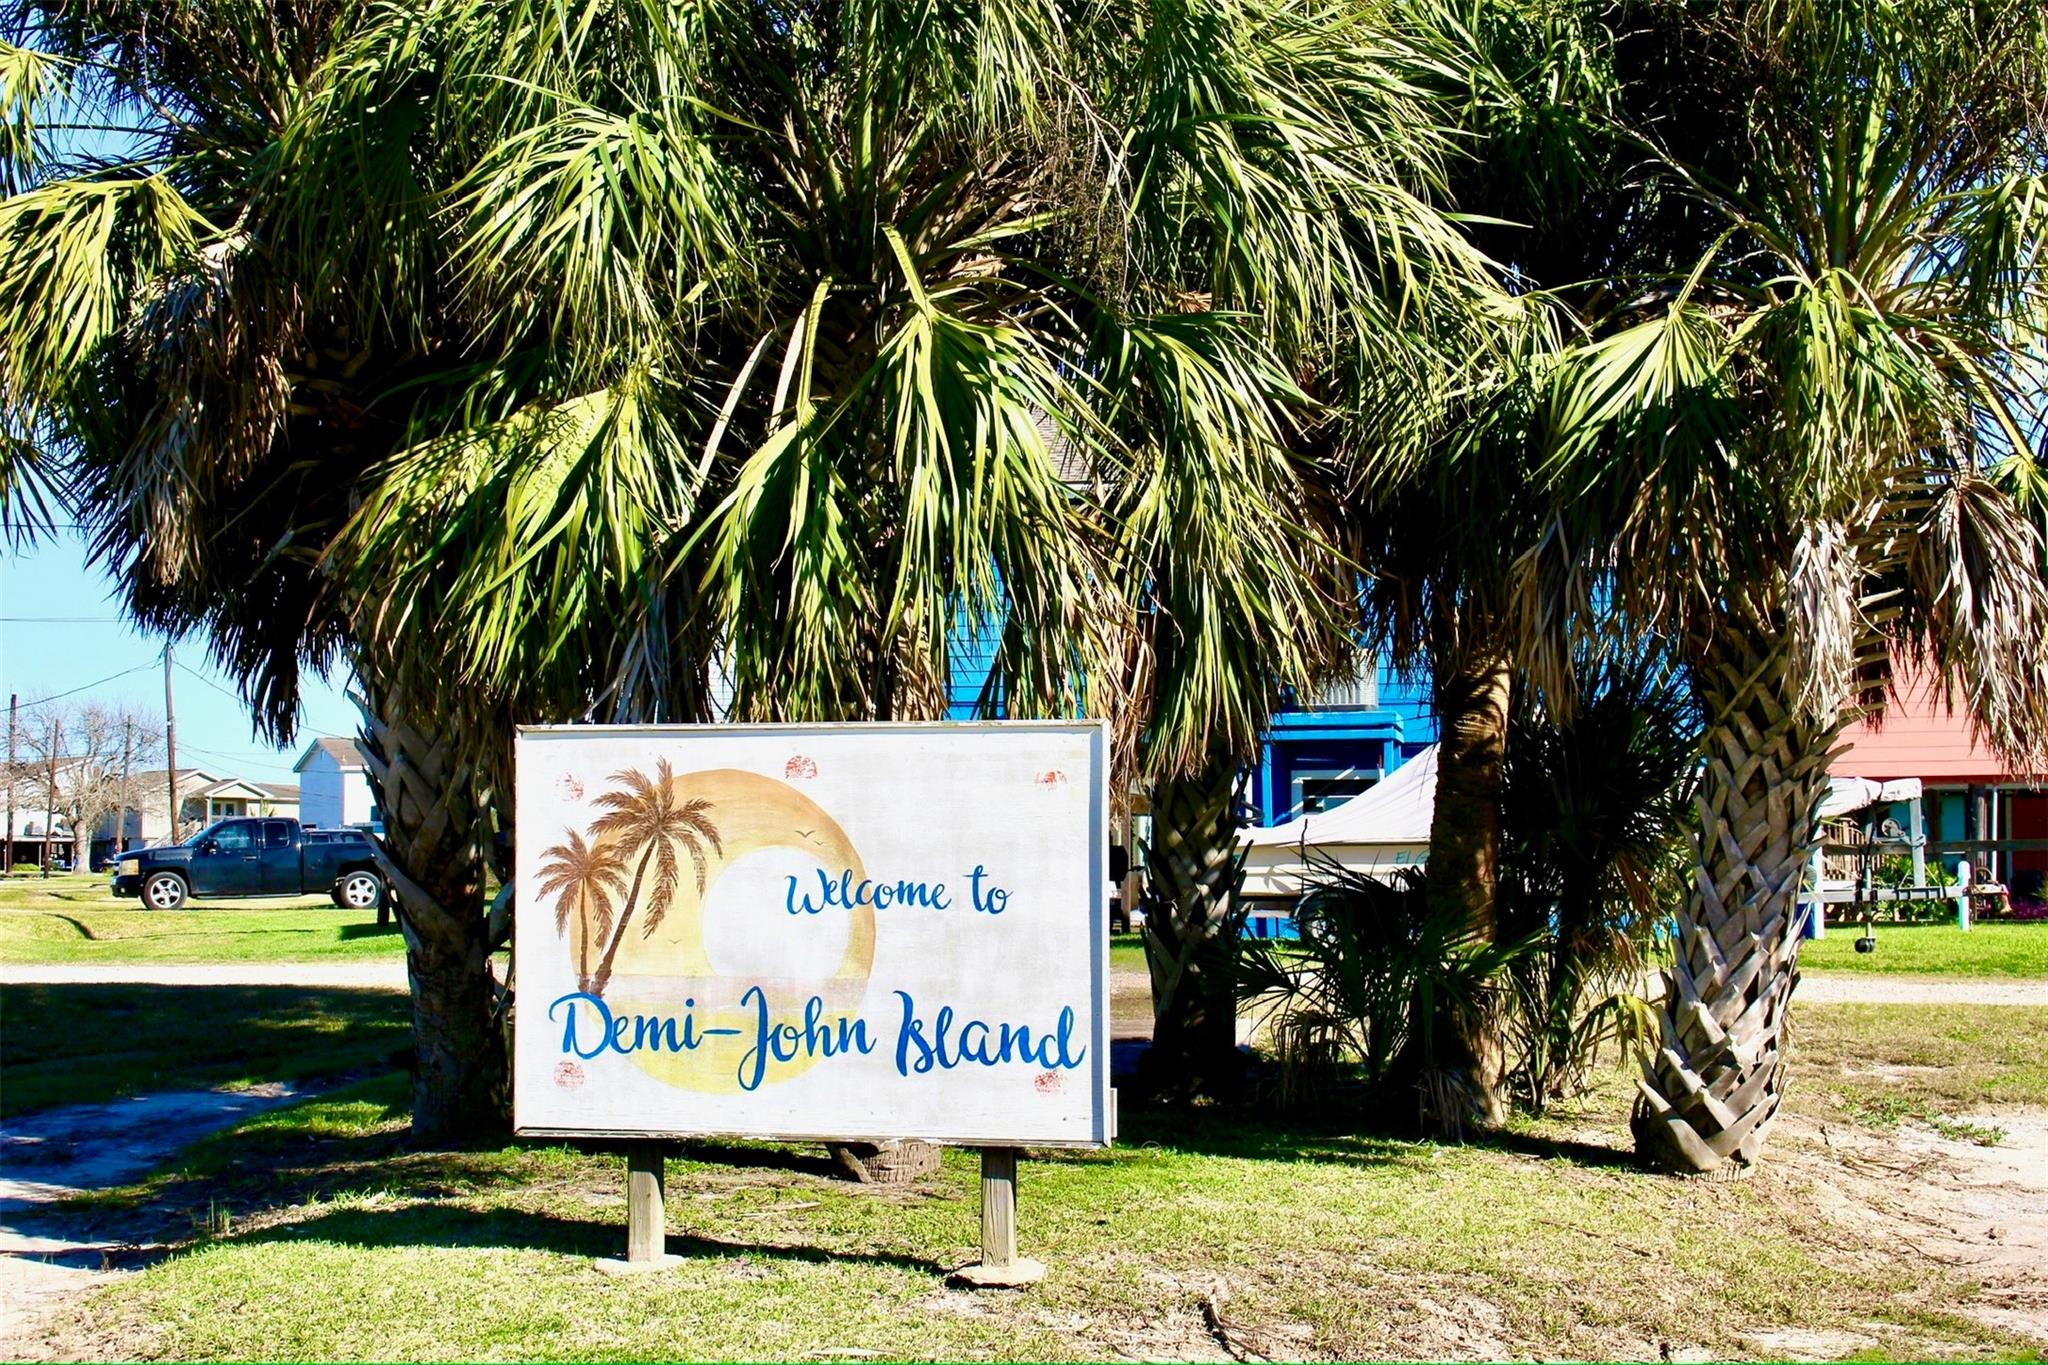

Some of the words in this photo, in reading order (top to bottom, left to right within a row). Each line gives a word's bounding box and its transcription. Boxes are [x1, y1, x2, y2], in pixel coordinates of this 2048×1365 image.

[784, 868, 953, 915] Welcome
[962, 864, 1014, 915] to
[548, 985, 877, 1092] Demi-John
[892, 990, 1087, 1077] Island
